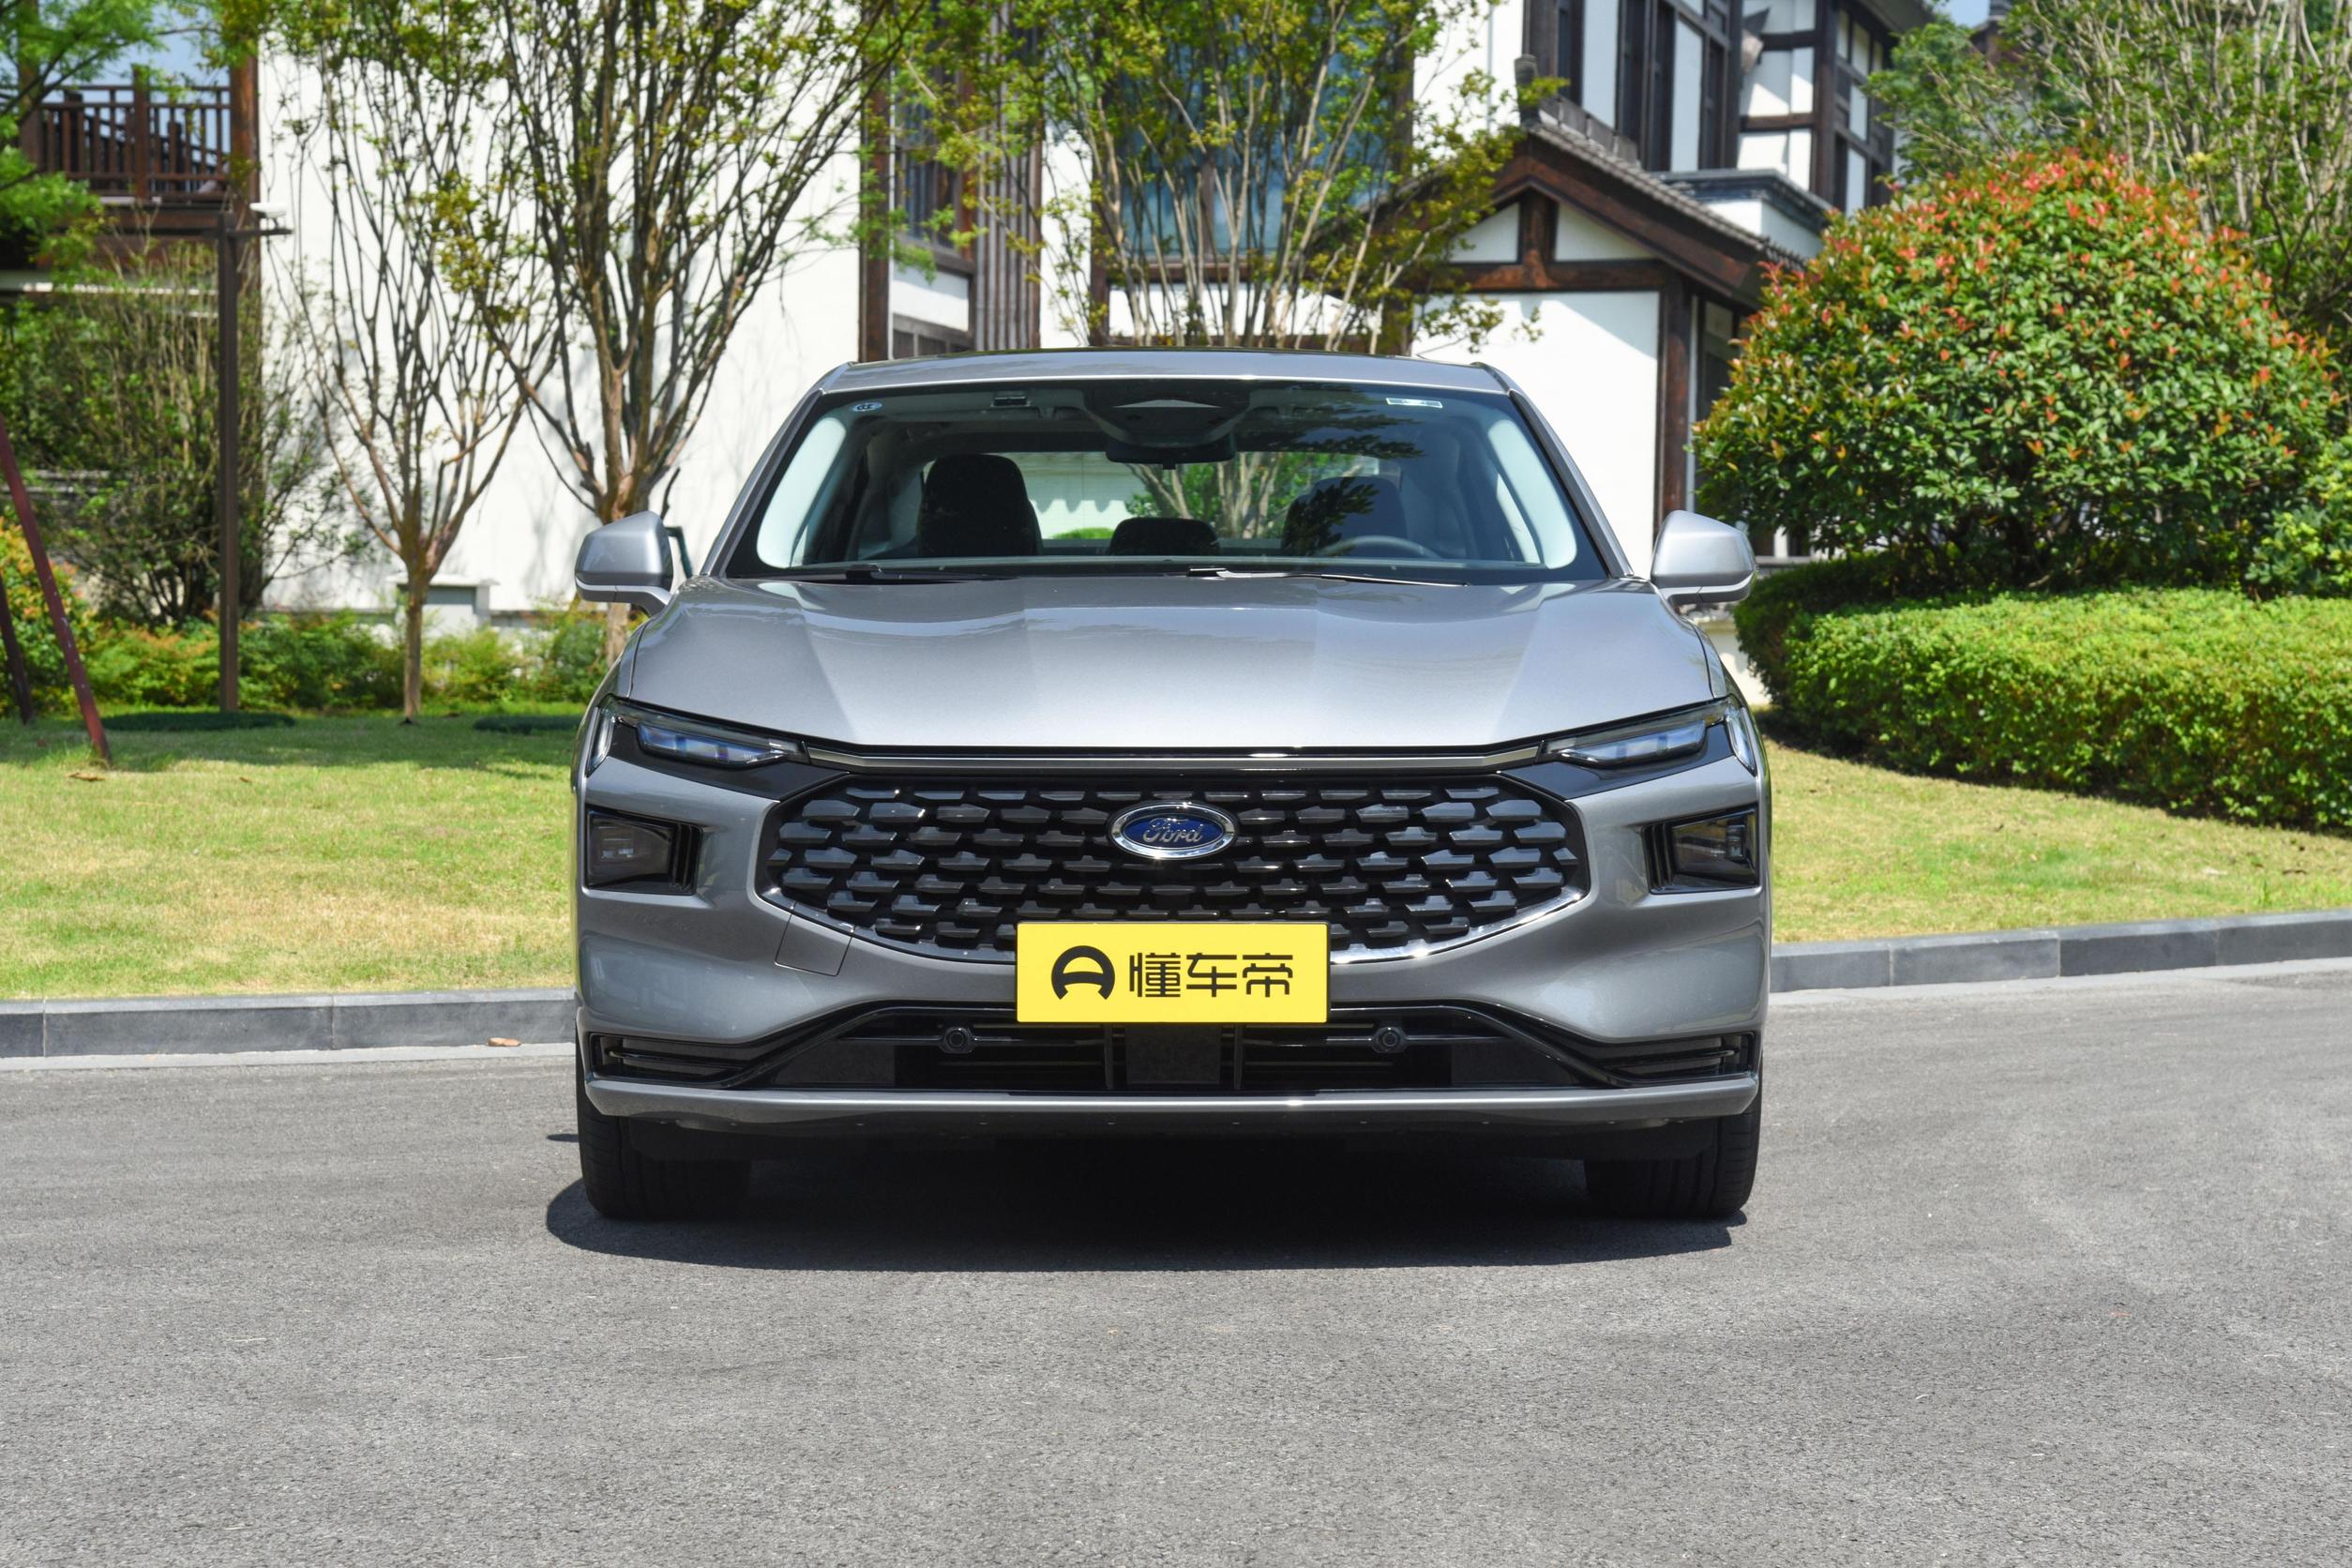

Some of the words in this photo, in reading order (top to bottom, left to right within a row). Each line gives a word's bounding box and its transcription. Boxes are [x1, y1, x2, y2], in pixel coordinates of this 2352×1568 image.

[1142, 818, 1204, 843] Ford
[1129, 952, 1293, 998] 懂车帝
